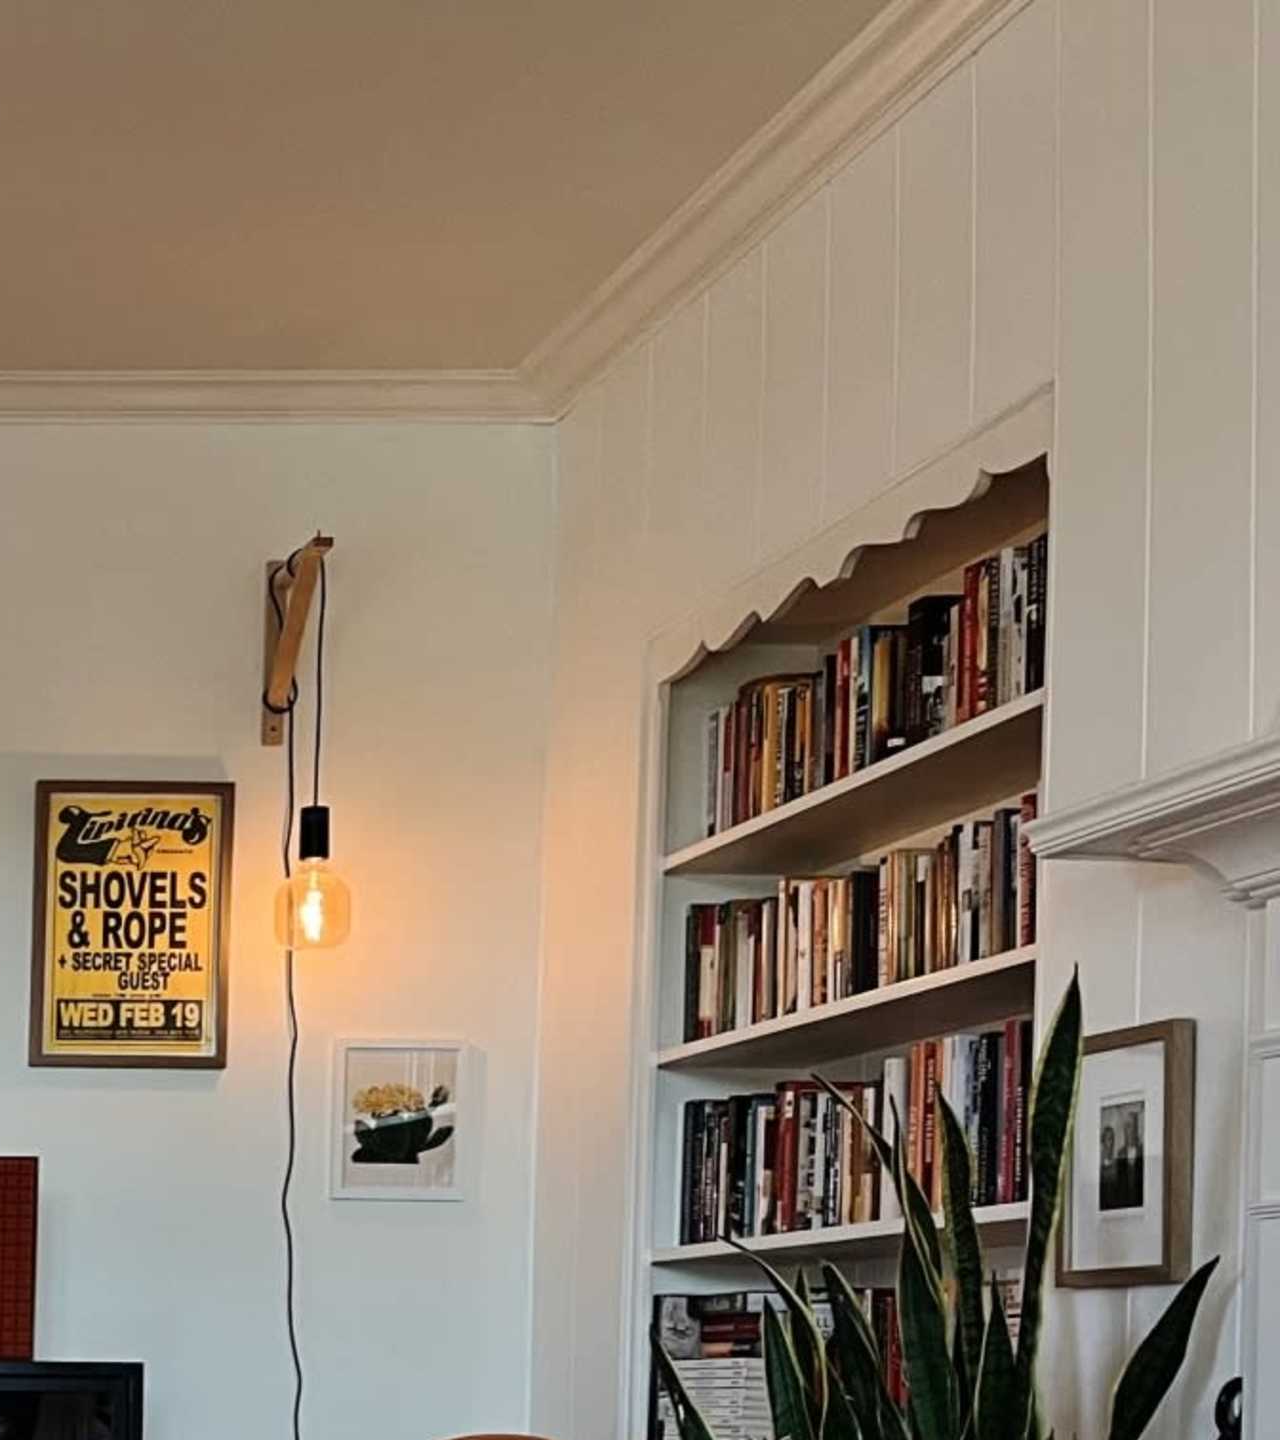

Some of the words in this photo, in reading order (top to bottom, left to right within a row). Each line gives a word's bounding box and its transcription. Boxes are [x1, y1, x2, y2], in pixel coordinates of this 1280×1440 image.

[58, 870, 208, 910] SHOVELS
[67, 910, 90, 949] &
[102, 911, 188, 949] ROPE
[72, 952, 132, 971] SECRET
[137, 952, 202, 972] SPECIAL
[118, 971, 170, 991] GUEST
[59, 1001, 114, 1028] WED
[119, 1001, 165, 1028] FEB
[171, 1001, 200, 1028] 19
